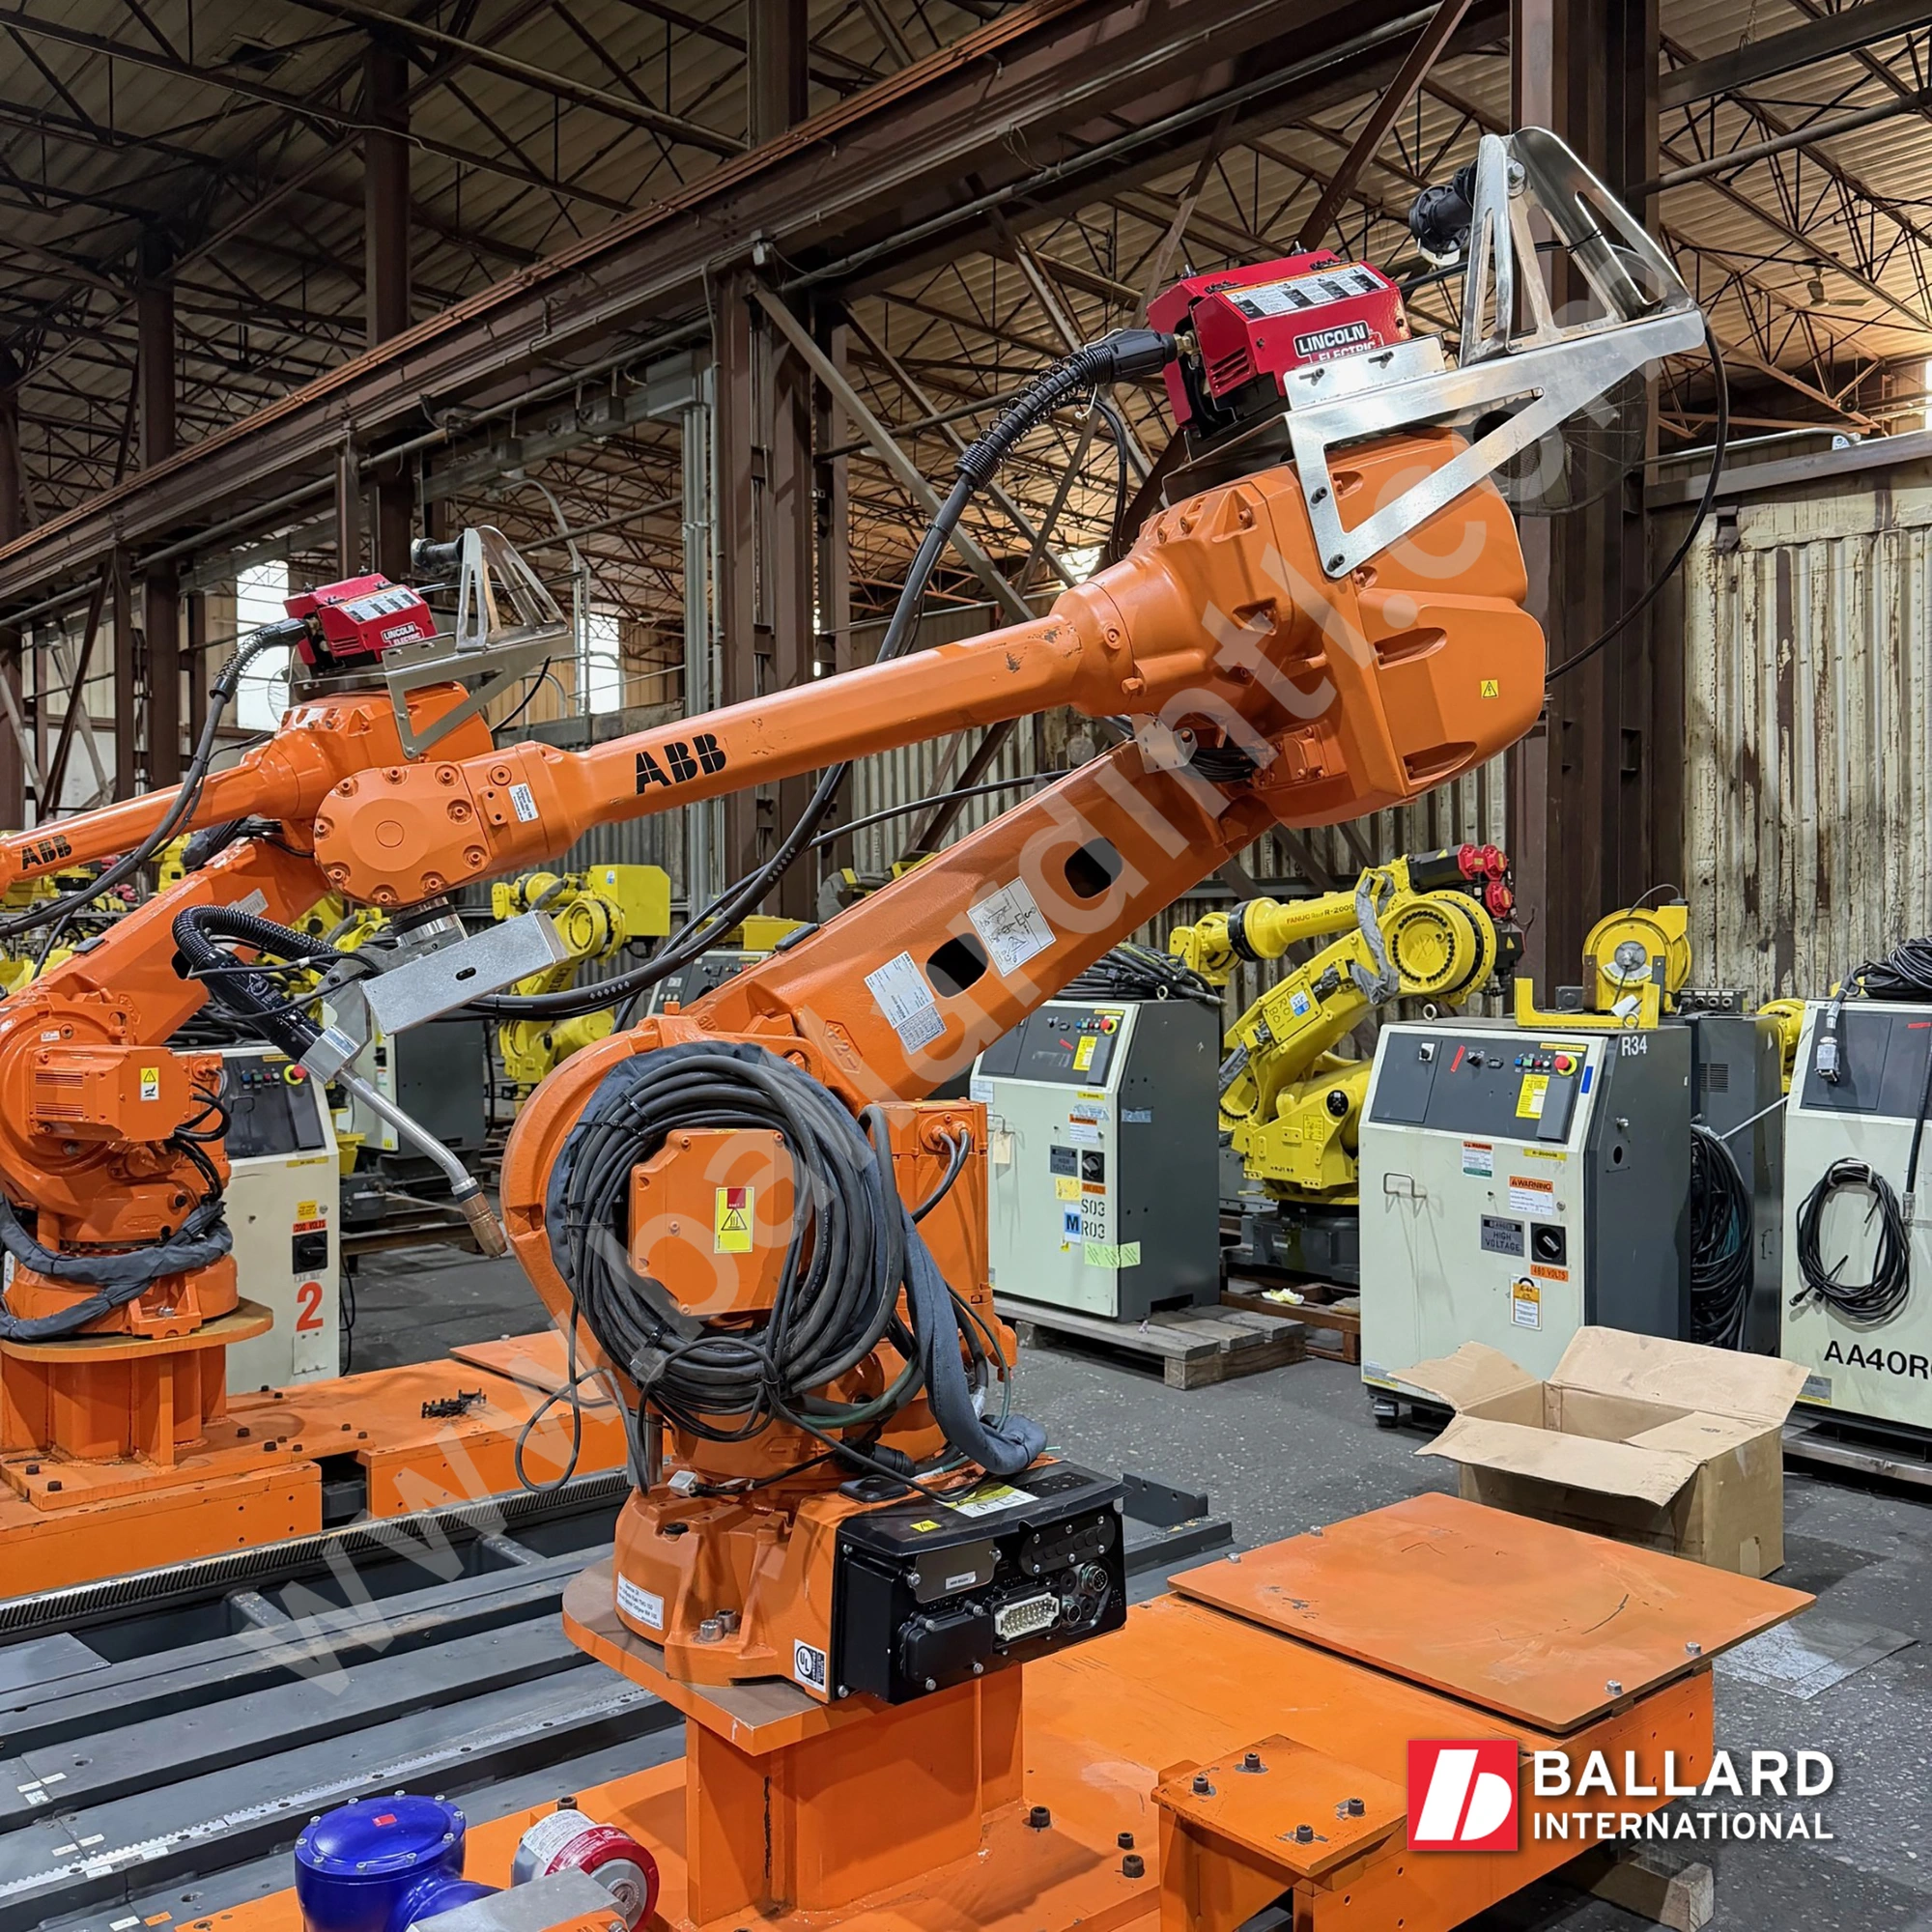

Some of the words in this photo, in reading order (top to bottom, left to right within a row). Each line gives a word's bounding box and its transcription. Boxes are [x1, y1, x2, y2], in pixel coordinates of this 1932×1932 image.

[1298, 325, 1366, 354] LINCOLN
[384, 624, 415, 639] LINCOLN
[636, 733, 726, 795] ABB
[21, 835, 72, 870] ABB
[1287, 914, 1311, 924] FANUC
[1622, 1035, 1648, 1056] R34
[1519, 1179, 1551, 1191] WARNING
[1081, 1198, 1105, 1217] S03
[1066, 1214, 1079, 1232] M
[1081, 1220, 1105, 1239] R03
[1485, 1238, 1520, 1252] VOLTAGE
[1493, 1232, 1512, 1240] HIGH
[1548, 1268, 1566, 1280] VOLTS
[296, 1282, 324, 1332] 2
[1824, 1340, 1932, 1379] AA40R
